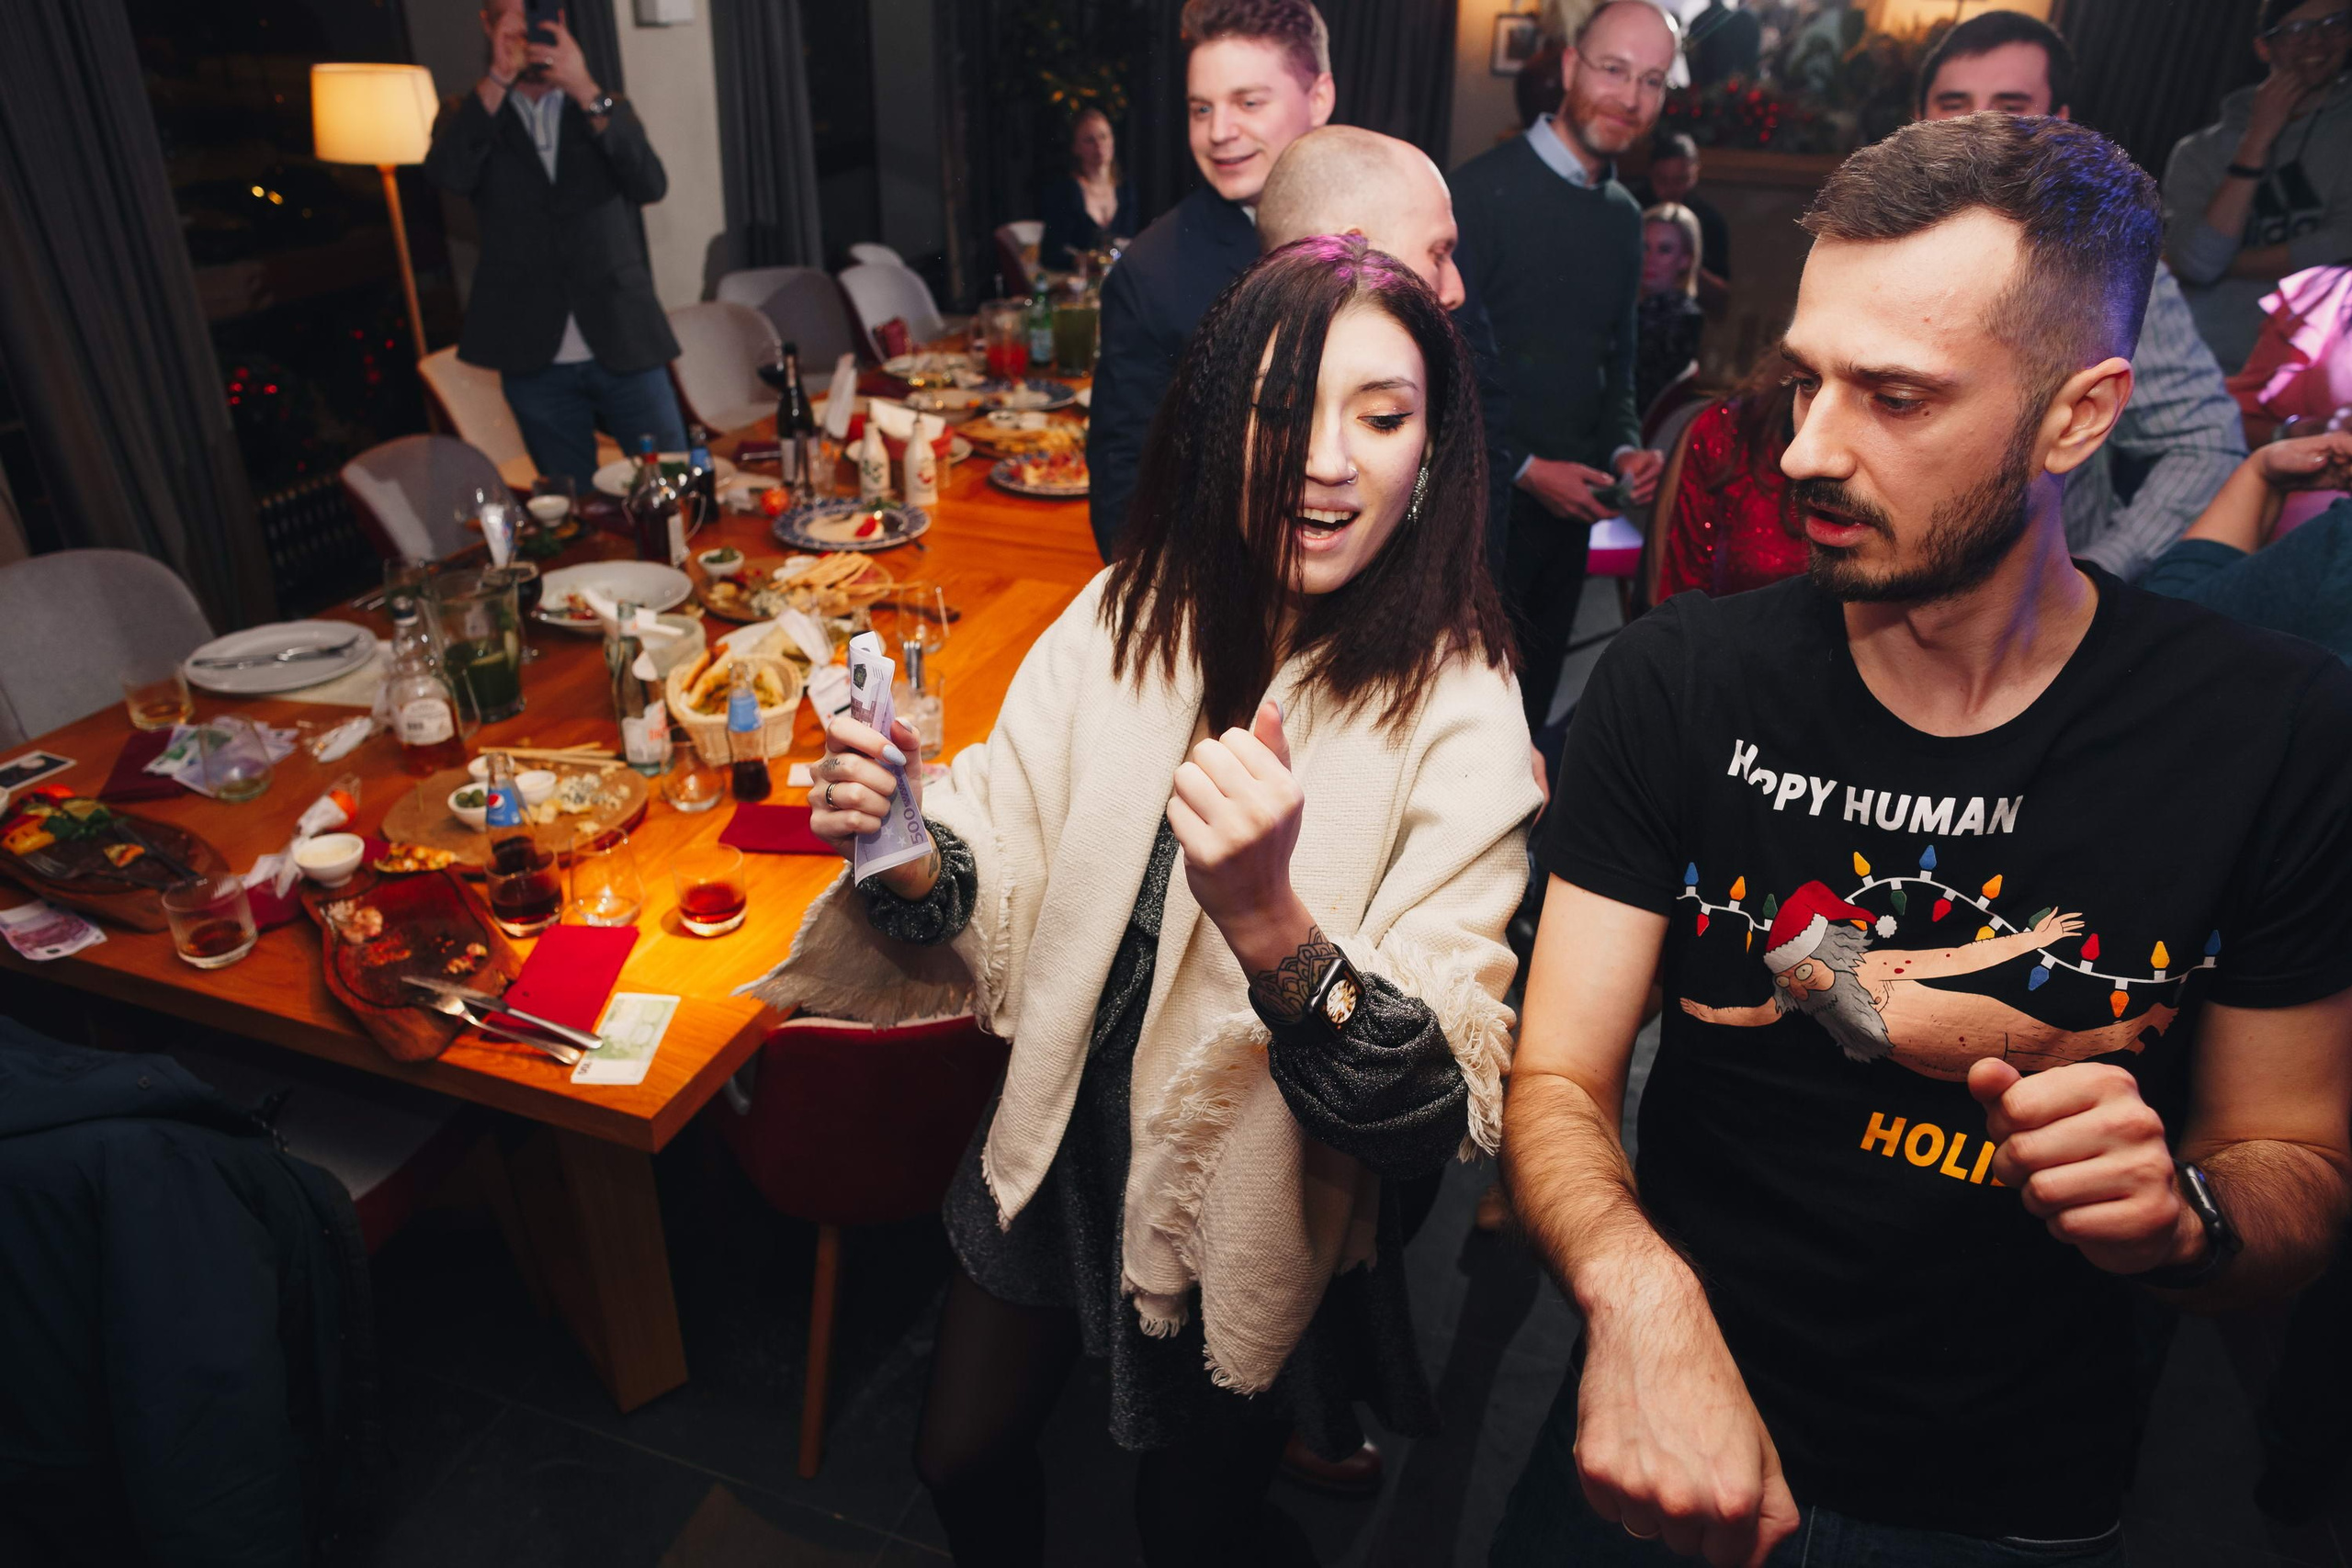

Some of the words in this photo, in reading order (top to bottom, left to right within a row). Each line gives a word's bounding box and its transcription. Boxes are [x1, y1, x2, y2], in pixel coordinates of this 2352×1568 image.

[904, 808, 923, 844] 500
[1843, 785, 2024, 836] HUMAN
[1860, 1111, 2007, 1187] HOLI
